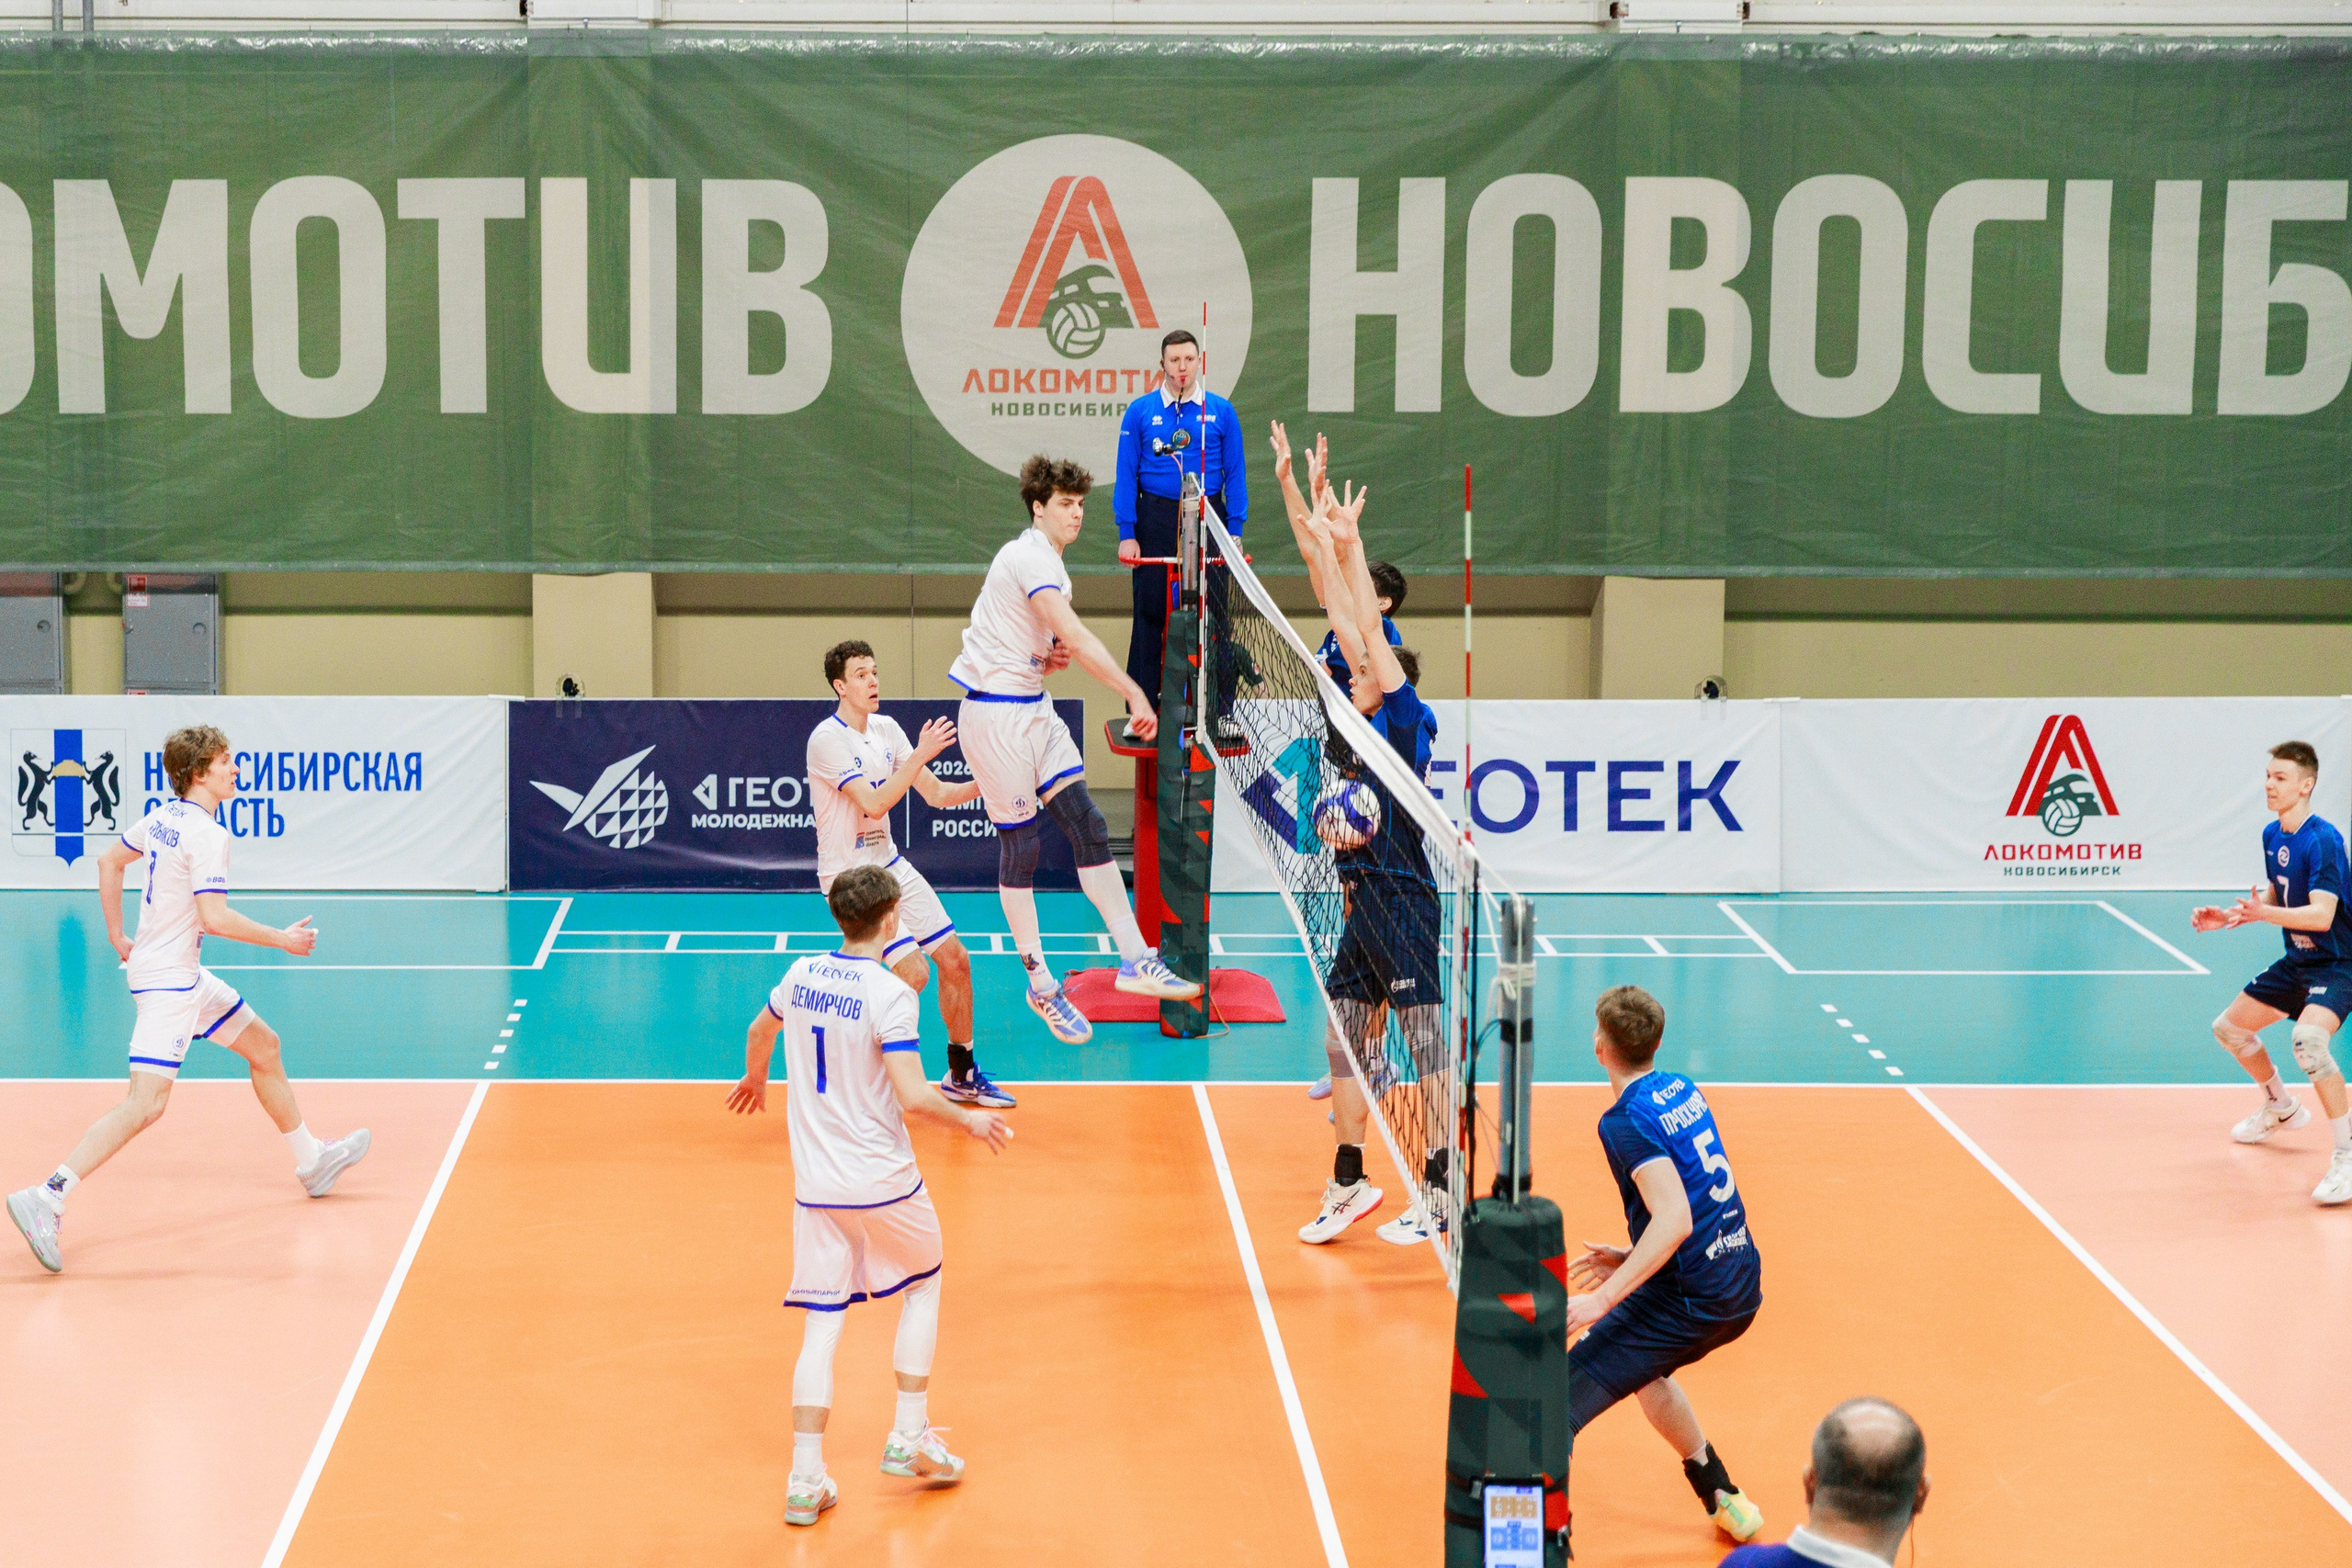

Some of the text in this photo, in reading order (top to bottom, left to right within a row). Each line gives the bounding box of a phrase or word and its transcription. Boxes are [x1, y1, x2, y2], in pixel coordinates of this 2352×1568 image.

[0, 175, 832, 418] МОТИВ
[962, 368, 1166, 393] ЛОКОМОТИ
[991, 402, 1127, 416] НОВОСИБИР
[144, 751, 422, 791] НСИБИРСКАЯ
[1430, 759, 1744, 834] ОТЕК
[692, 814, 816, 829] МОЛОДЕЖНА
[933, 819, 998, 837] РОССИ
[1984, 844, 2142, 861] ЛОКОМОТИВ
[2004, 866, 2120, 875] НОВОСИБИРСК
[791, 984, 863, 1021] ДЕМИРЧОВ
[811, 1025, 827, 1094] 1
[1692, 1128, 1735, 1202] 5
